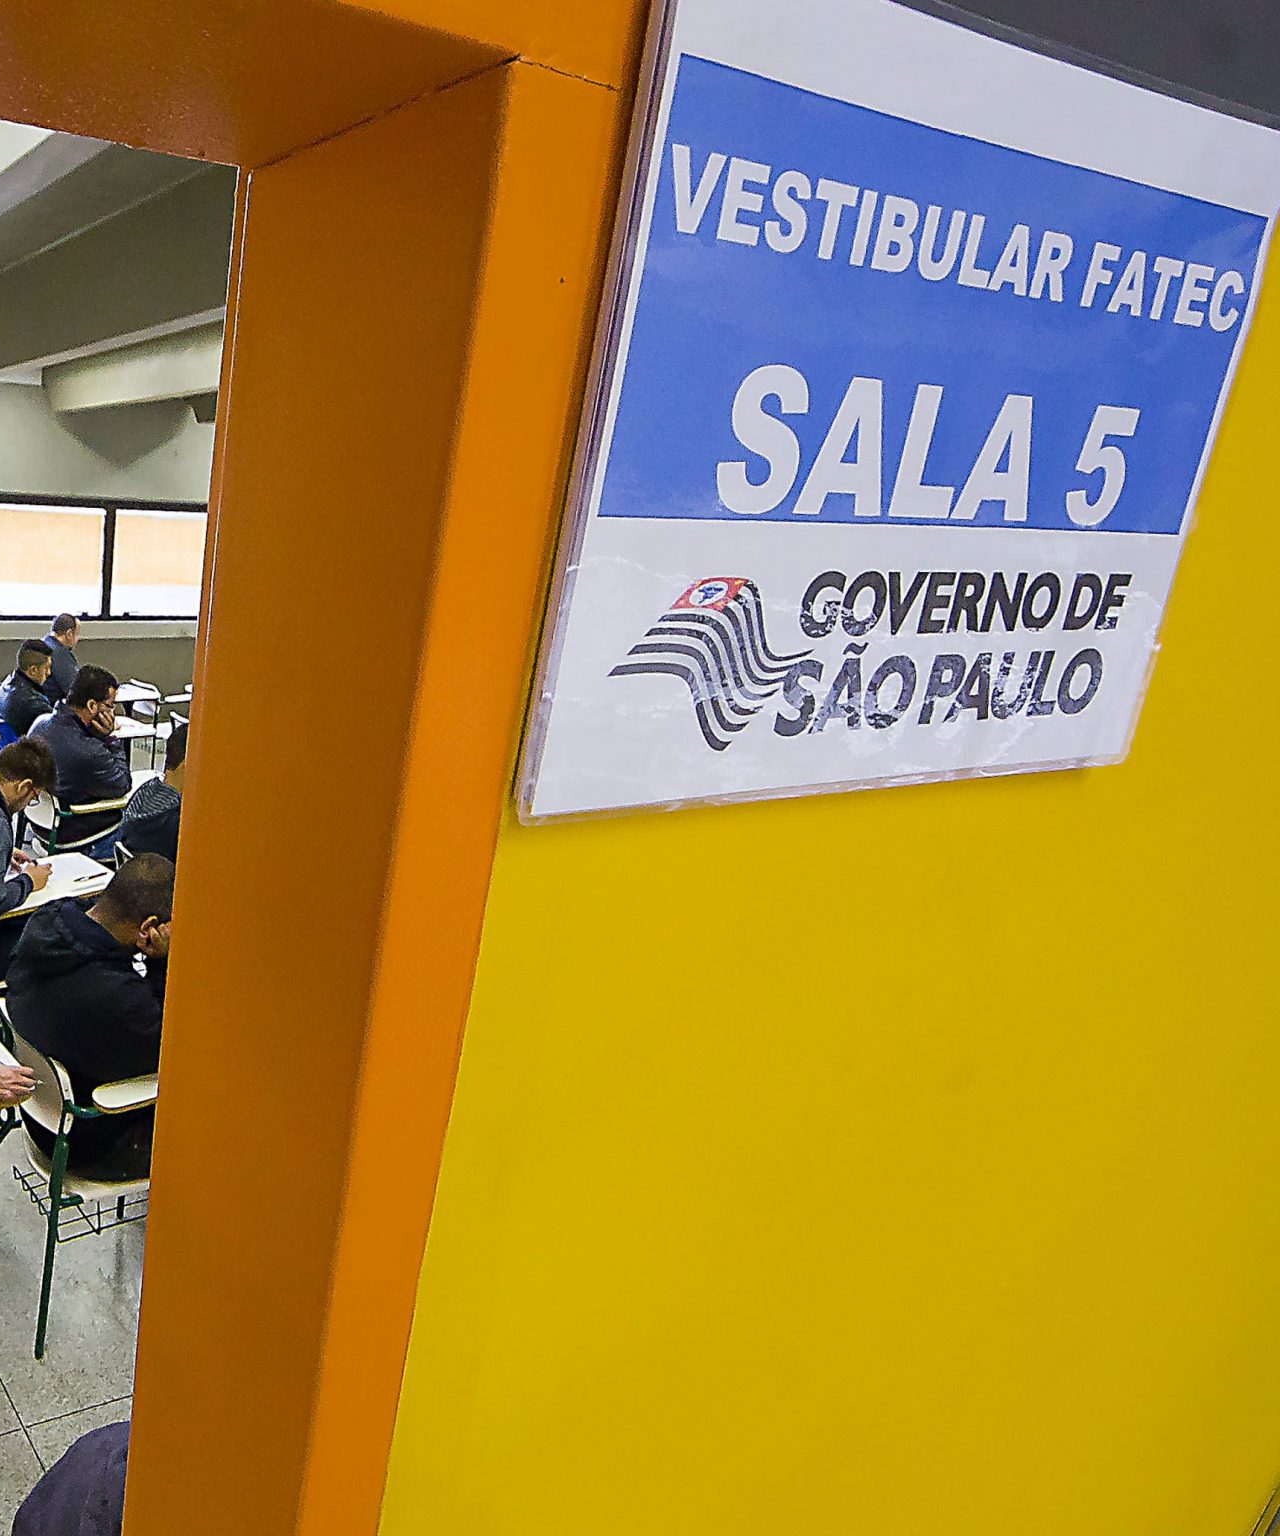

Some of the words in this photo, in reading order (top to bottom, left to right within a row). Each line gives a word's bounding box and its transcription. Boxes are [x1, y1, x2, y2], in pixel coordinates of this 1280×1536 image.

[671, 145, 1072, 302] VESTIBULAR
[1081, 242, 1245, 333] FATEC
[717, 364, 1034, 522] SALA
[1066, 405, 1140, 526] 5
[800, 571, 1057, 637] GOVERNO
[1064, 572, 1133, 631] DE
[773, 643, 917, 736] SÃO
[919, 647, 1102, 727] PAULO
